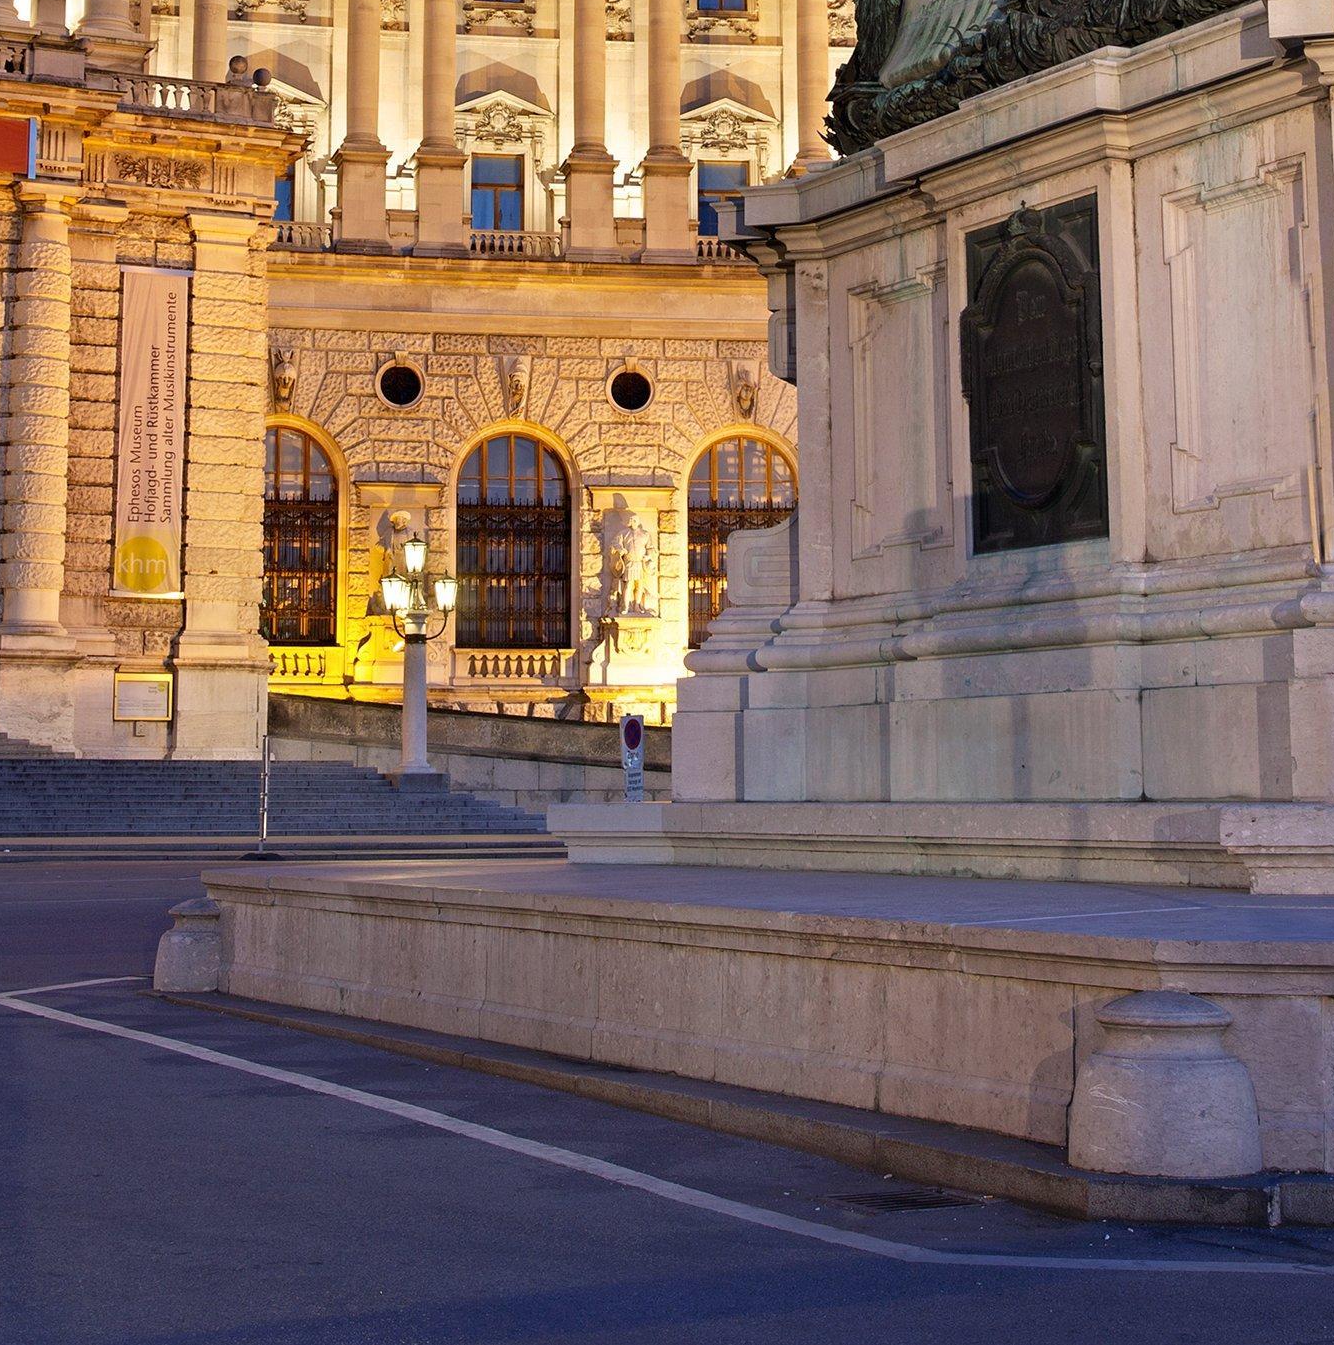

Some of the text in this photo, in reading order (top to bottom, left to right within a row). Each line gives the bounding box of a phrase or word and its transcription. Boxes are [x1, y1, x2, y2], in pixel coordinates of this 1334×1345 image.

[127, 405, 143, 523] Ephesos Museum
[144, 344, 161, 523] Hofjagd- und Rüstkammer
[160, 291, 177, 524] Sammlung alter Musikinstrumente
[117, 551, 167, 575] khm
